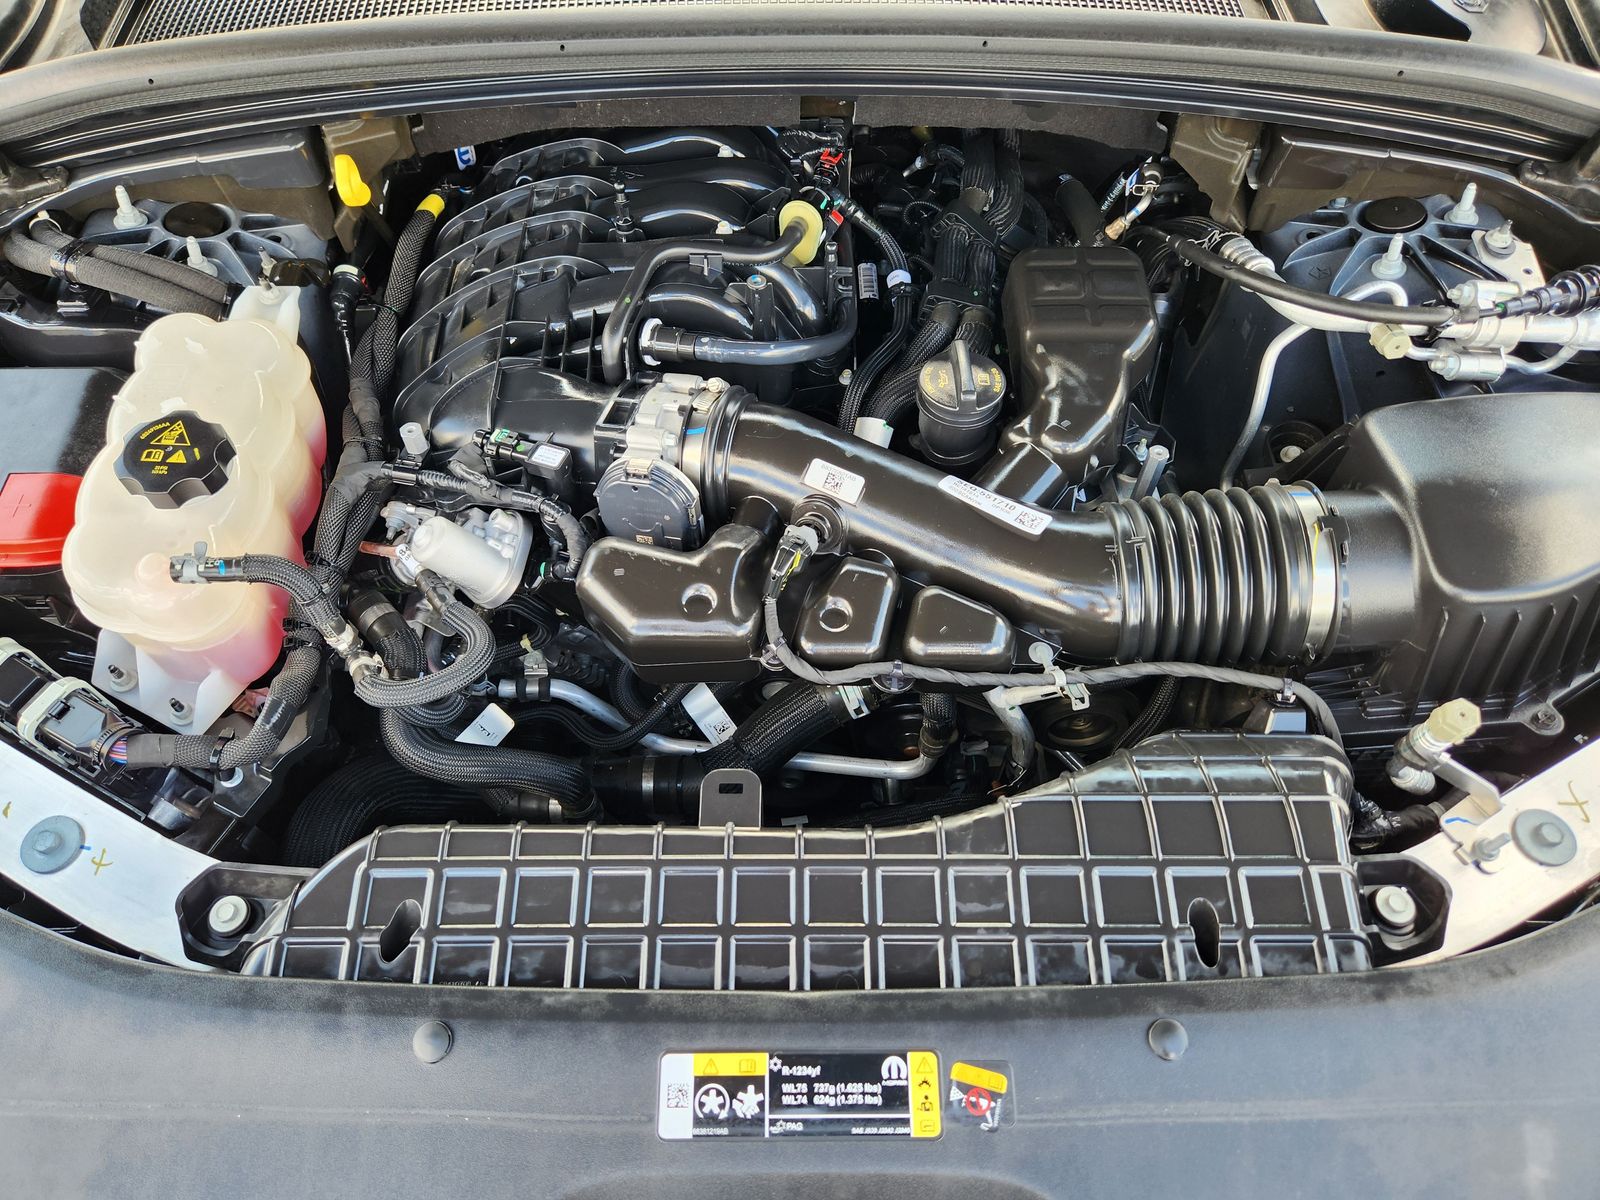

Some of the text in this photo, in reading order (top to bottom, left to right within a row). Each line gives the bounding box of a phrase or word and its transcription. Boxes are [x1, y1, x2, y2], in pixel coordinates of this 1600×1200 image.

[782, 1065, 822, 1078] R-1234yf
[813, 1083, 836, 1095] 737g
[864, 1082, 882, 1095] lbs)
[782, 1095, 808, 1105] WL74
[864, 1094, 883, 1106] lbs)
[786, 1121, 804, 1131] PAG
